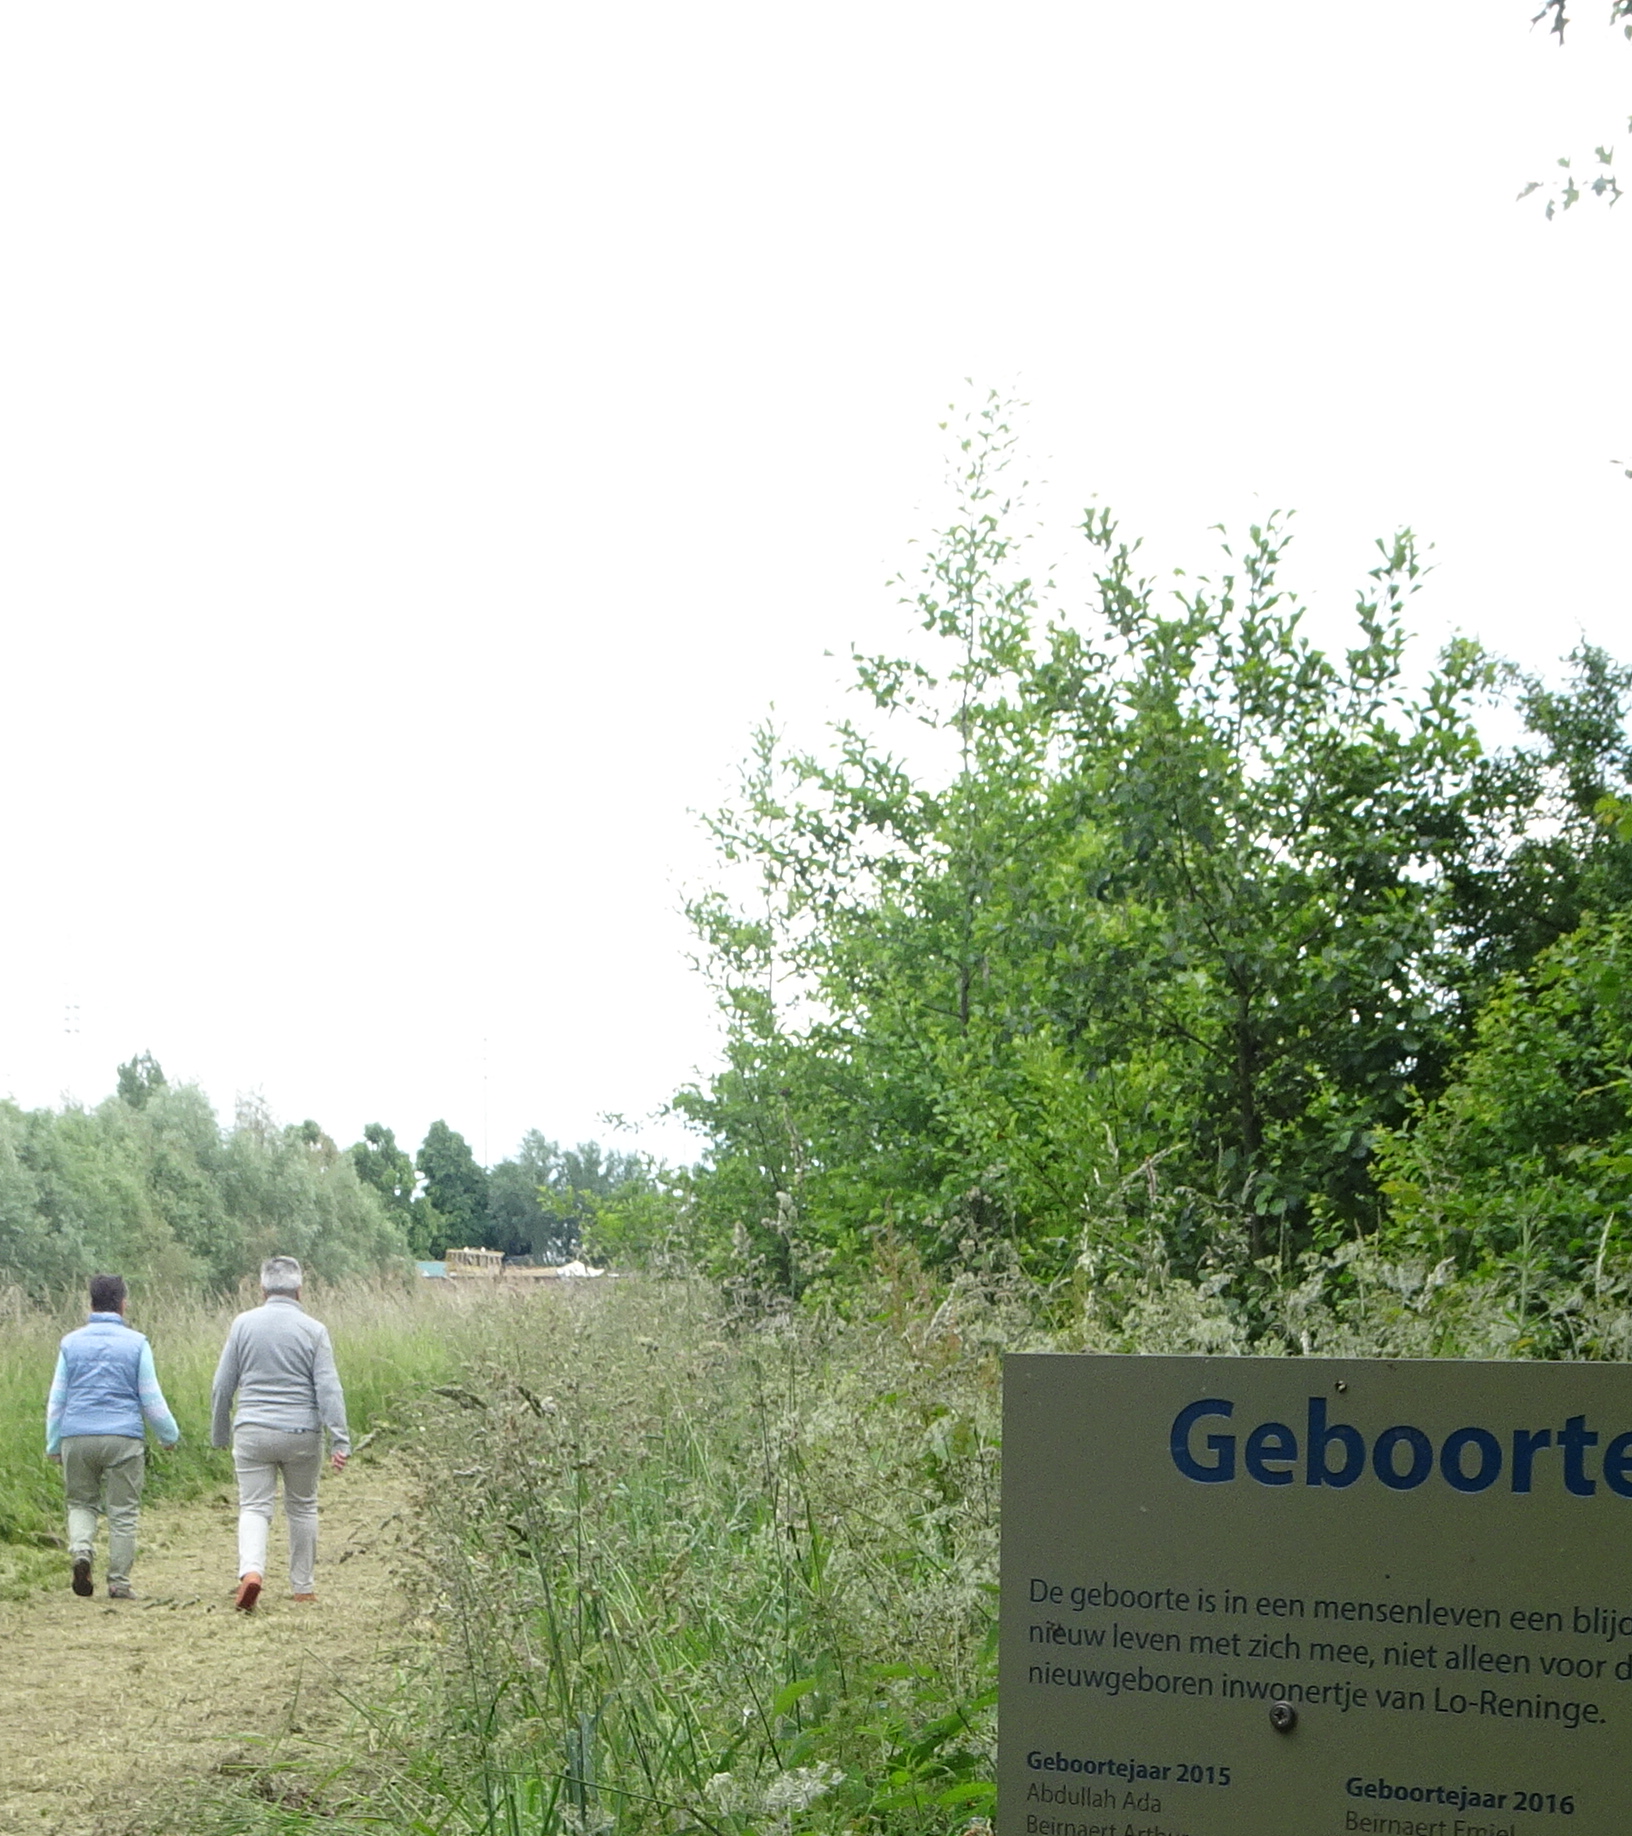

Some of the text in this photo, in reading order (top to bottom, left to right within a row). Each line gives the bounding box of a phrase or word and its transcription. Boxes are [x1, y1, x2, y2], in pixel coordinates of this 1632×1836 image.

[1030, 1579, 1063, 1604] De
[1071, 1582, 1189, 1611] geboorte
[1198, 1590, 1216, 1612] is
[1225, 1589, 1247, 1613] in
[1256, 1598, 1304, 1617] een
[1314, 1598, 1500, 1628] mensenleven
[1510, 1611, 1562, 1631] een
[1030, 1621, 1106, 1646] nieuw
[1114, 1623, 1180, 1651] leven
[1190, 1634, 1240, 1657] met
[1248, 1633, 1300, 1659] zich
[1310, 1643, 1374, 1668] mee,
[1385, 1642, 1437, 1668] niet
[1446, 1644, 1529, 1673] alleen
[1540, 1657, 1606, 1678] voor
[1030, 1666, 1605, 1728] nieuwgeboren inwonertje van Lo-Reninge.
[1027, 1751, 1230, 1785] Geboortejaar 2015
[1027, 1783, 1161, 1813] Abdullah Ada
[1346, 1778, 1574, 1814] Geboortejaar 2016
